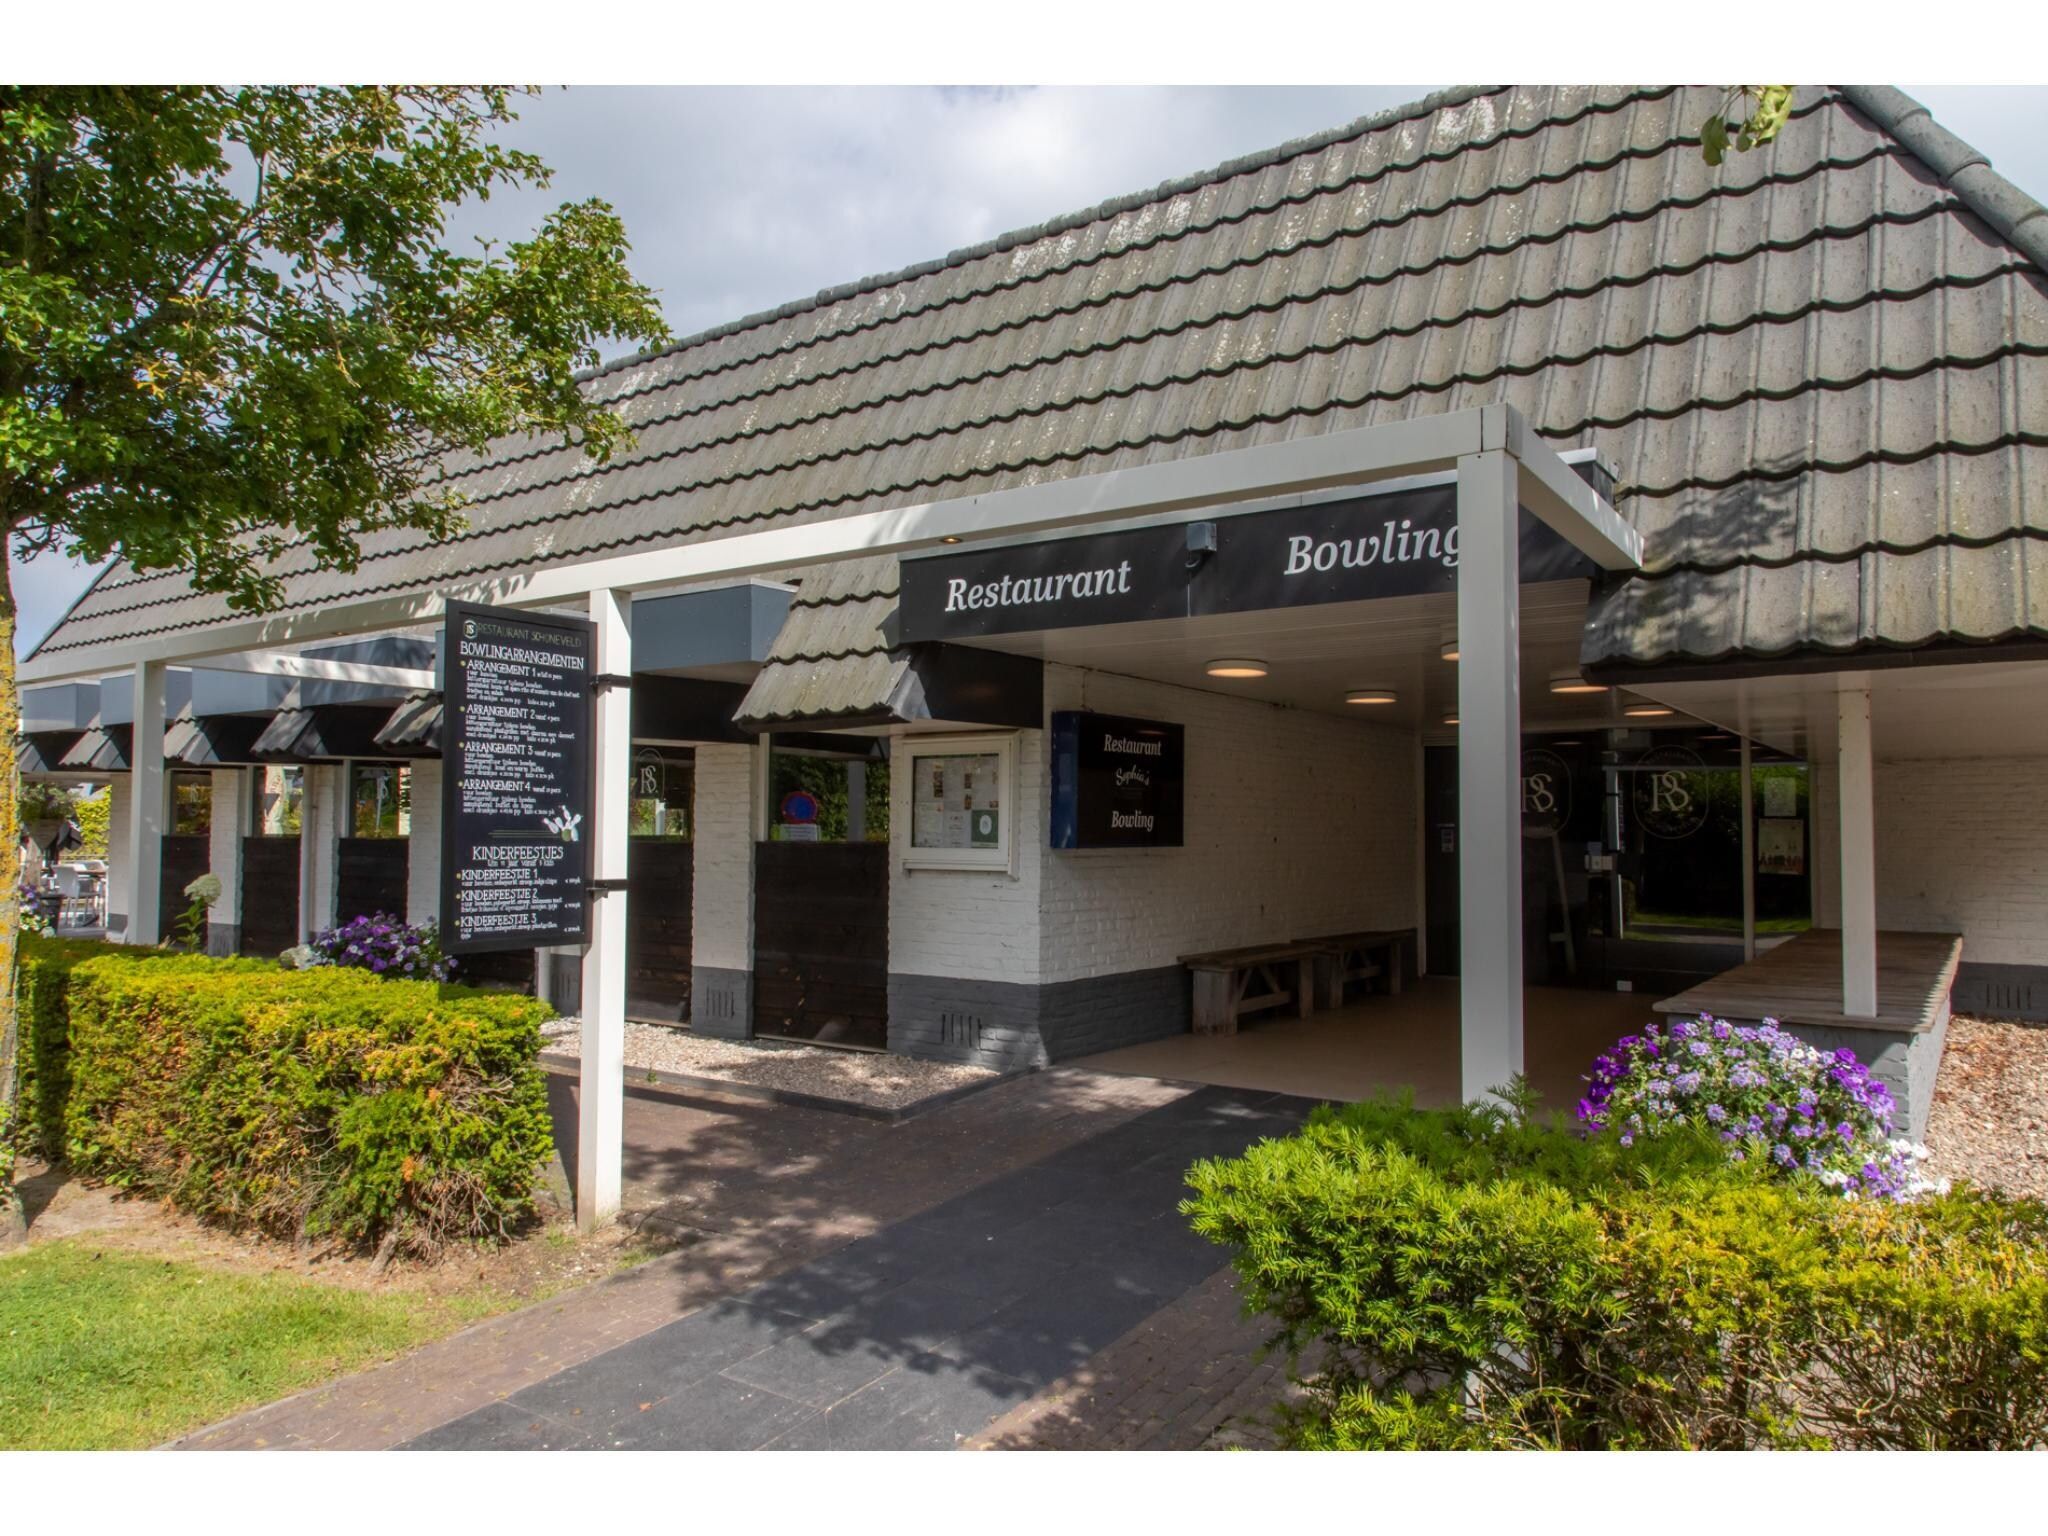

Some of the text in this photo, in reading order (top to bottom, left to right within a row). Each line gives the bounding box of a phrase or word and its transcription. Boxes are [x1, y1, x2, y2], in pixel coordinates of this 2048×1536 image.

[1284, 519, 1458, 575] Bowling
[945, 560, 1131, 612] Restaurant
[479, 622, 529, 641] RESTAURANT
[460, 640, 584, 670] BOWLINGARRANGEMENTEN
[467, 659, 530, 677] ARRANGEMENT
[532, 667, 537, 677] 1
[466, 703, 528, 719] ARRANGEMENT
[530, 709, 536, 720] 2
[464, 741, 527, 755] ARRANGEMENT
[527, 745, 534, 756] 3
[1104, 733, 1162, 756] Restaurant
[463, 778, 524, 792] ARRANGEMENT
[524, 781, 531, 792] 4
[1111, 810, 1154, 832] Bowling
[472, 845, 564, 860] KINDERFEESTJES
[461, 869, 538, 881] KINDERFEESTJE 1
[461, 888, 538, 901] KINDERFEESTJE 2
[460, 914, 529, 928] KINDERFEESTJE
[530, 913, 537, 924] 3
